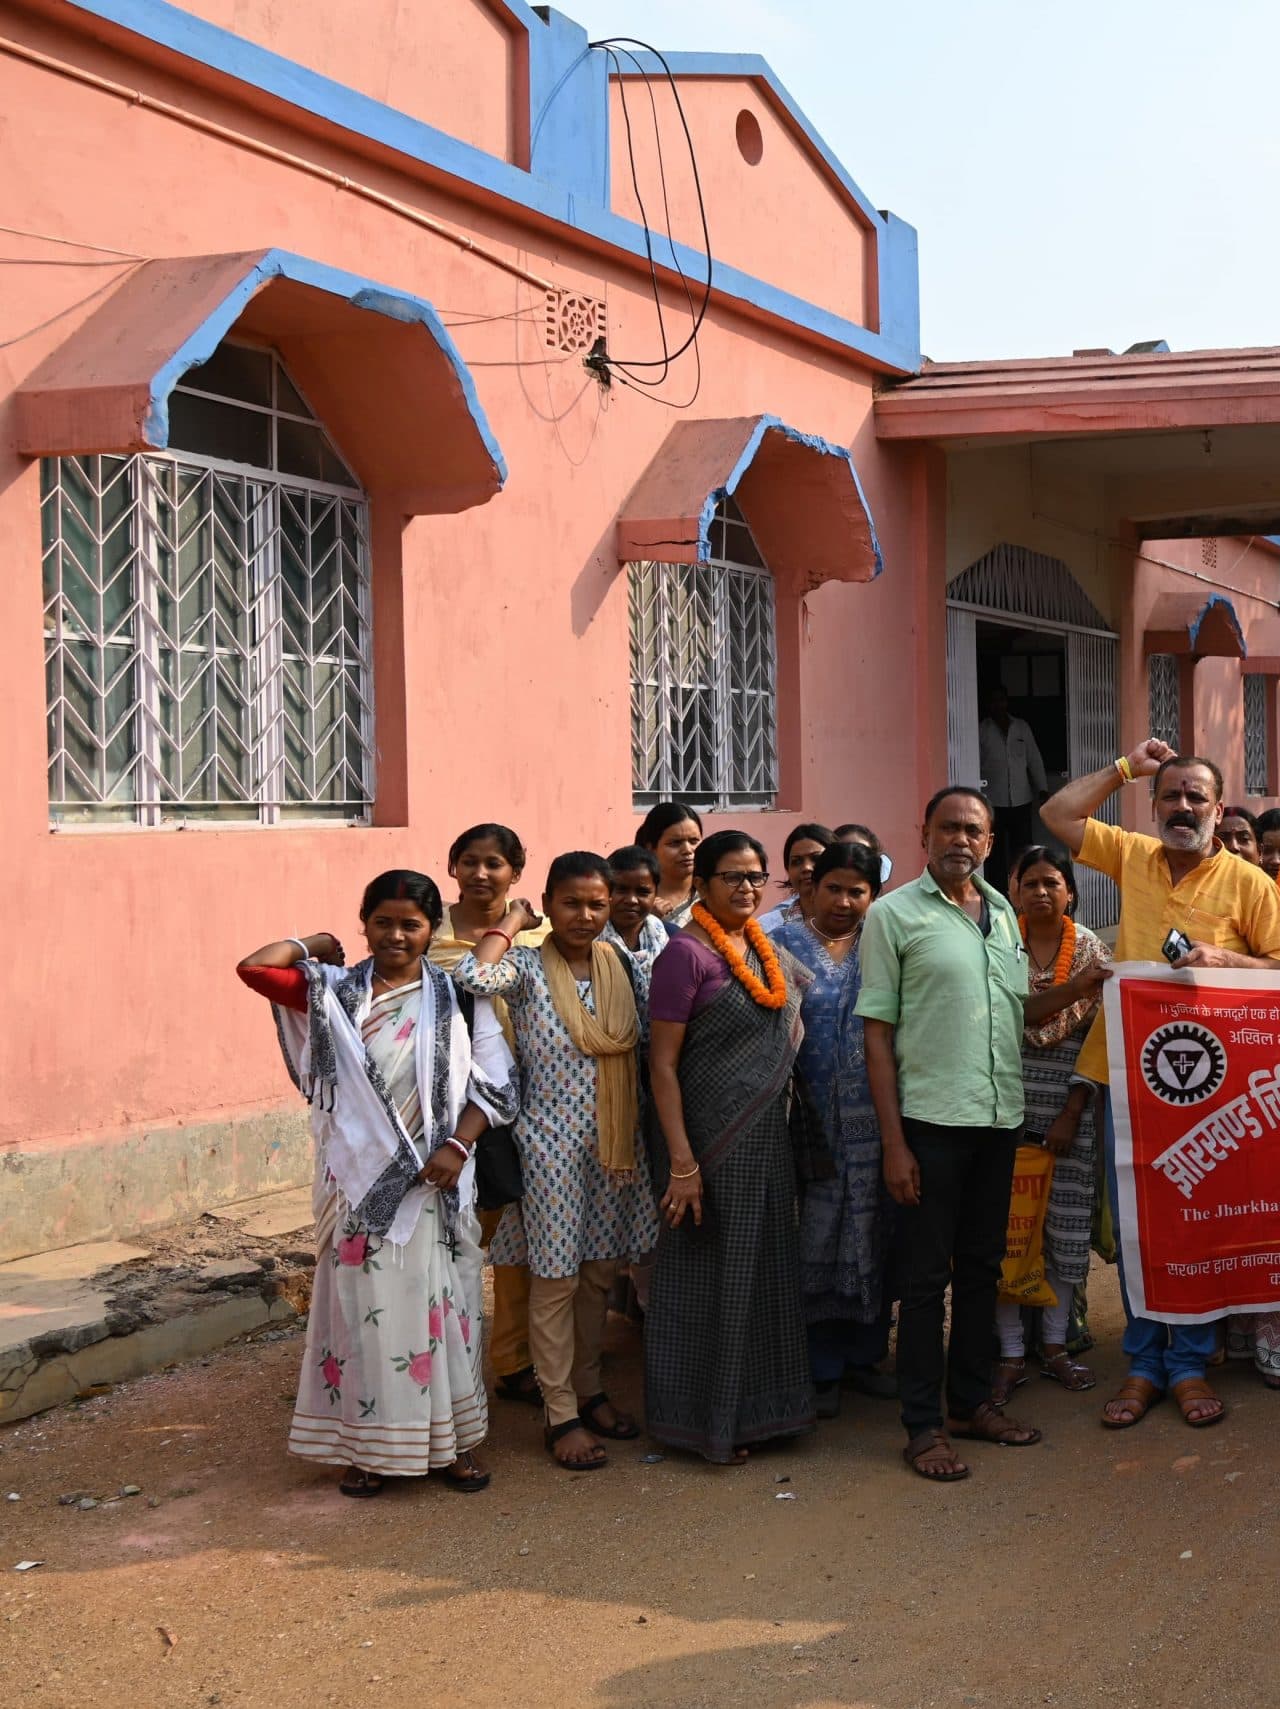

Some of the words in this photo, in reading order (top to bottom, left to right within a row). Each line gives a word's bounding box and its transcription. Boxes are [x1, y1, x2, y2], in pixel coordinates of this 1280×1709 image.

[1200, 1004, 1212, 1017] के
[1213, 1005, 1249, 1021] मजदूरों
[1250, 1008, 1267, 1020] एक
[1229, 1028, 1274, 1046] अखिल
[1151, 1093, 1264, 1200] झारखण्ड
[1181, 1207, 1210, 1222] The
[1166, 1261, 1211, 1277] सरकार
[1212, 1257, 1238, 1275] द्वारा
